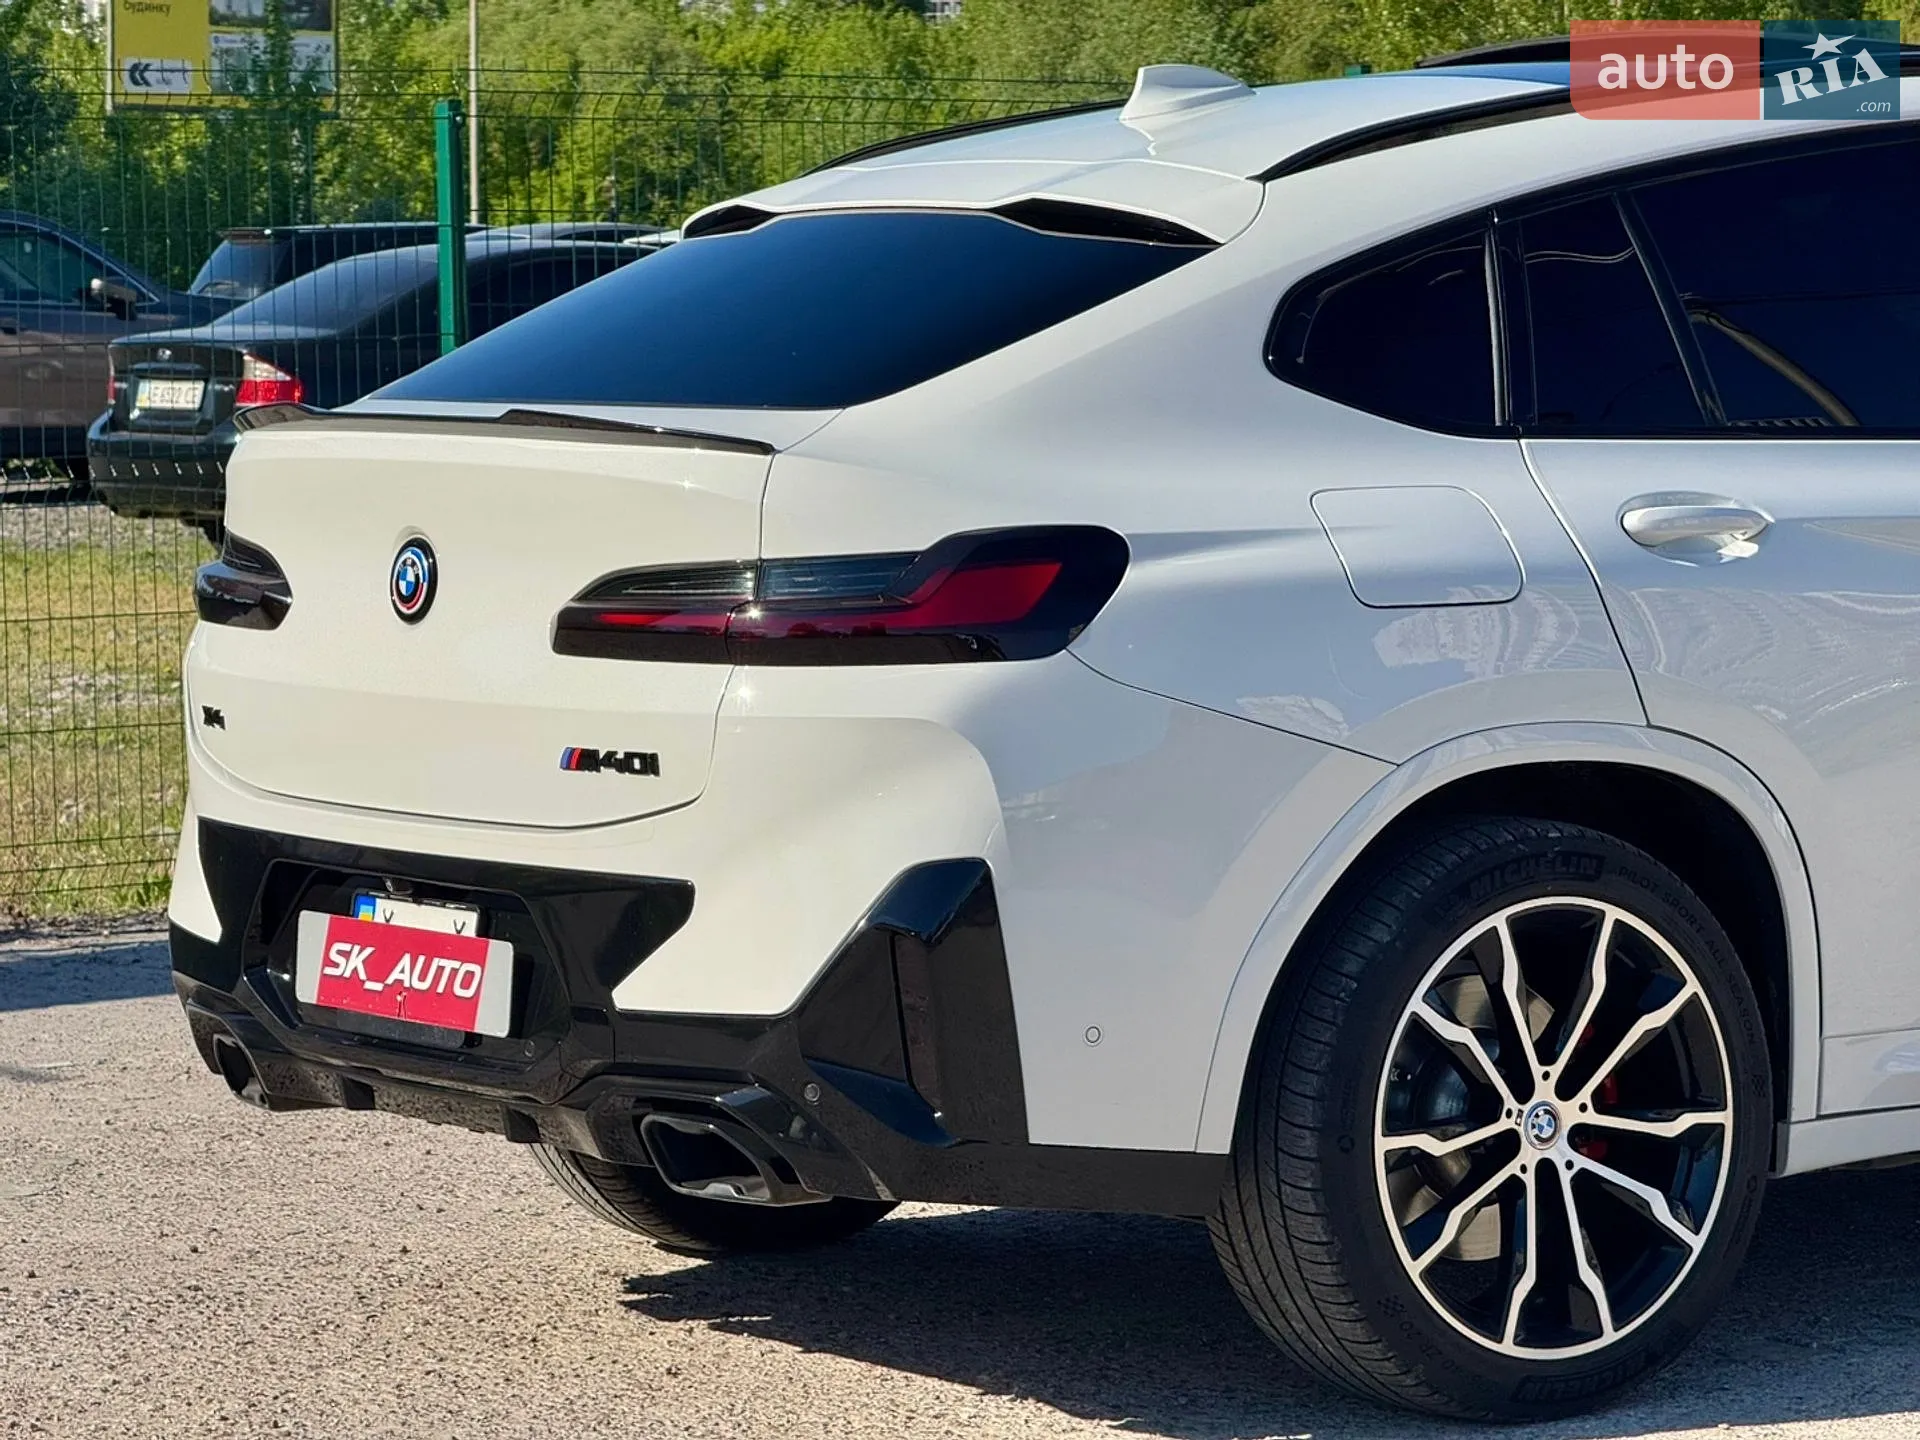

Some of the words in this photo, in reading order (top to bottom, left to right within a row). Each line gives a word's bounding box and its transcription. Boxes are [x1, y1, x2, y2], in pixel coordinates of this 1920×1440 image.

[202, 705, 226, 730] X4
[1469, 855, 1600, 898] MICHELIN
[1618, 866, 1659, 896] PILOT
[1661, 891, 1706, 936] SPORT
[1705, 938, 1728, 967] ALL
[323, 942, 482, 998] SK_AUTO
